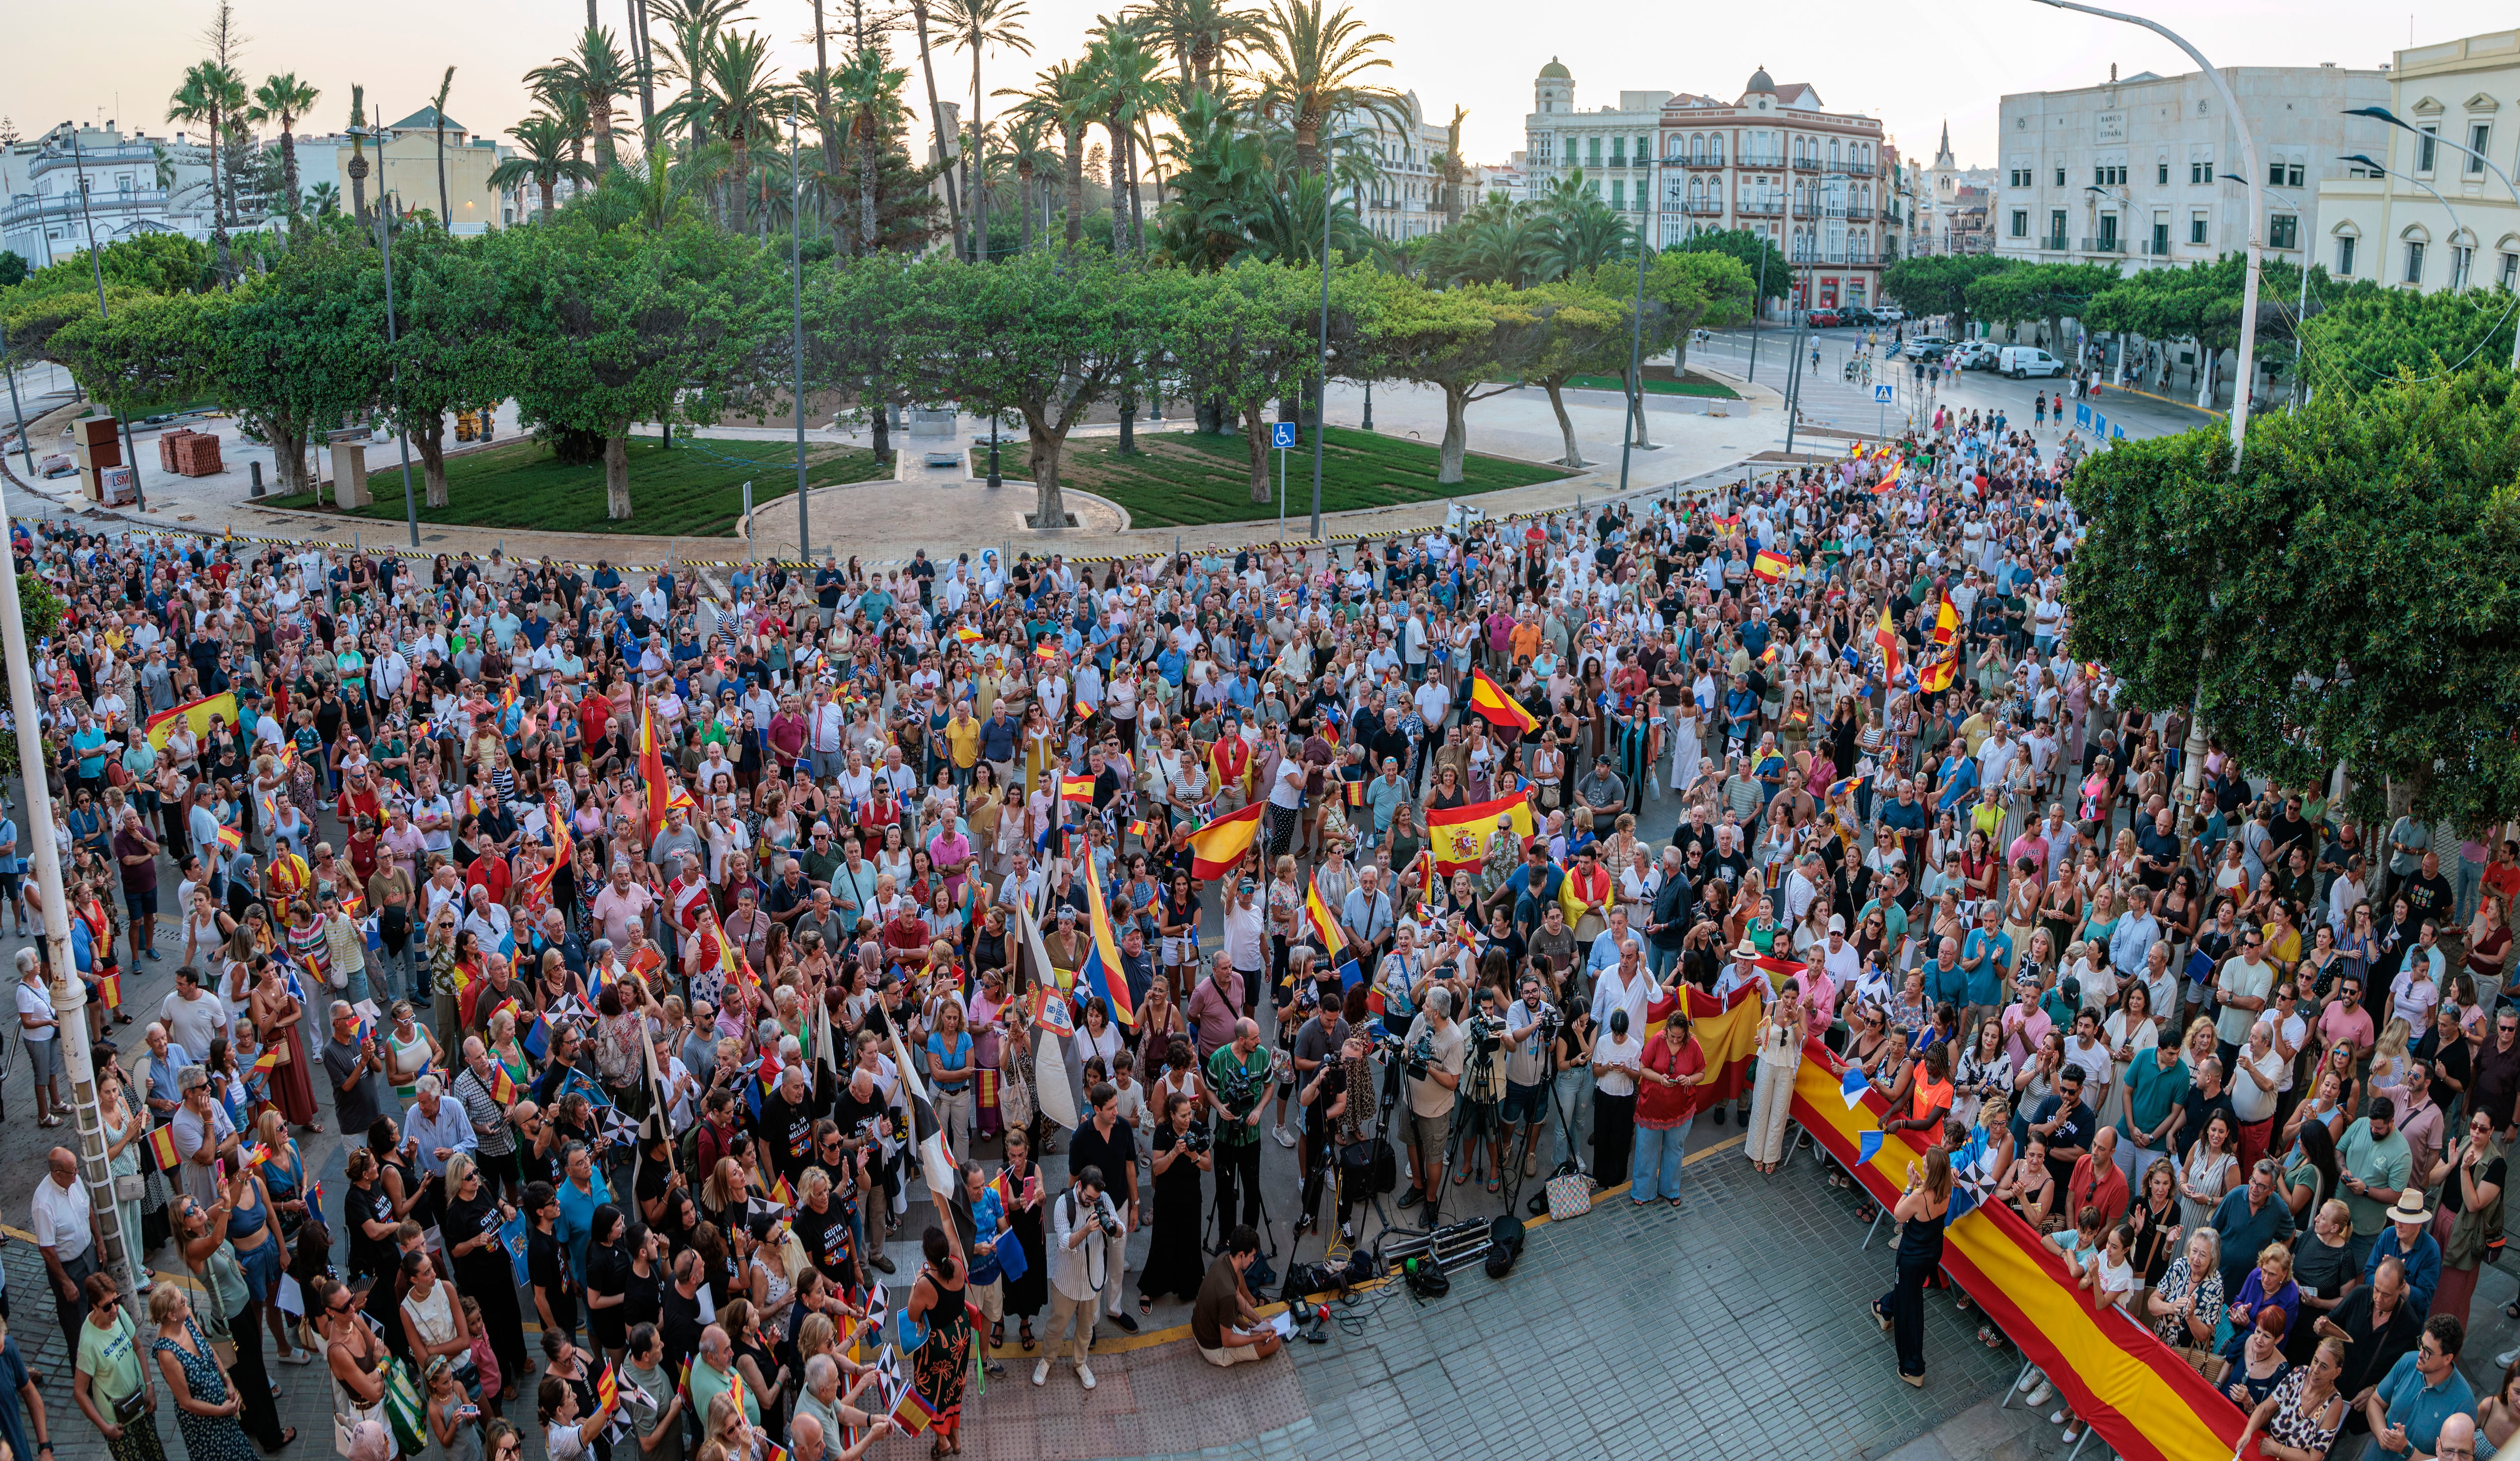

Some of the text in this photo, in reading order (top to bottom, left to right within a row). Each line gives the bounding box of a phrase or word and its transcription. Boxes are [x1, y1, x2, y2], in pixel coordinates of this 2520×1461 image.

[2100, 129, 2121, 138] ESPAÑA
[112, 475, 129, 487] LSM
[2024, 849, 2040, 857] BIKE
[789, 1123, 810, 1140] MELILLA
[480, 1208, 498, 1227] CEUTA
[824, 1223, 843, 1239] CEUTA
[824, 1230, 848, 1250] MELILLA
[115, 1341, 133, 1362] LOVE
[1888, 1381, 2007, 1448] CONSTRUIDO COMO
